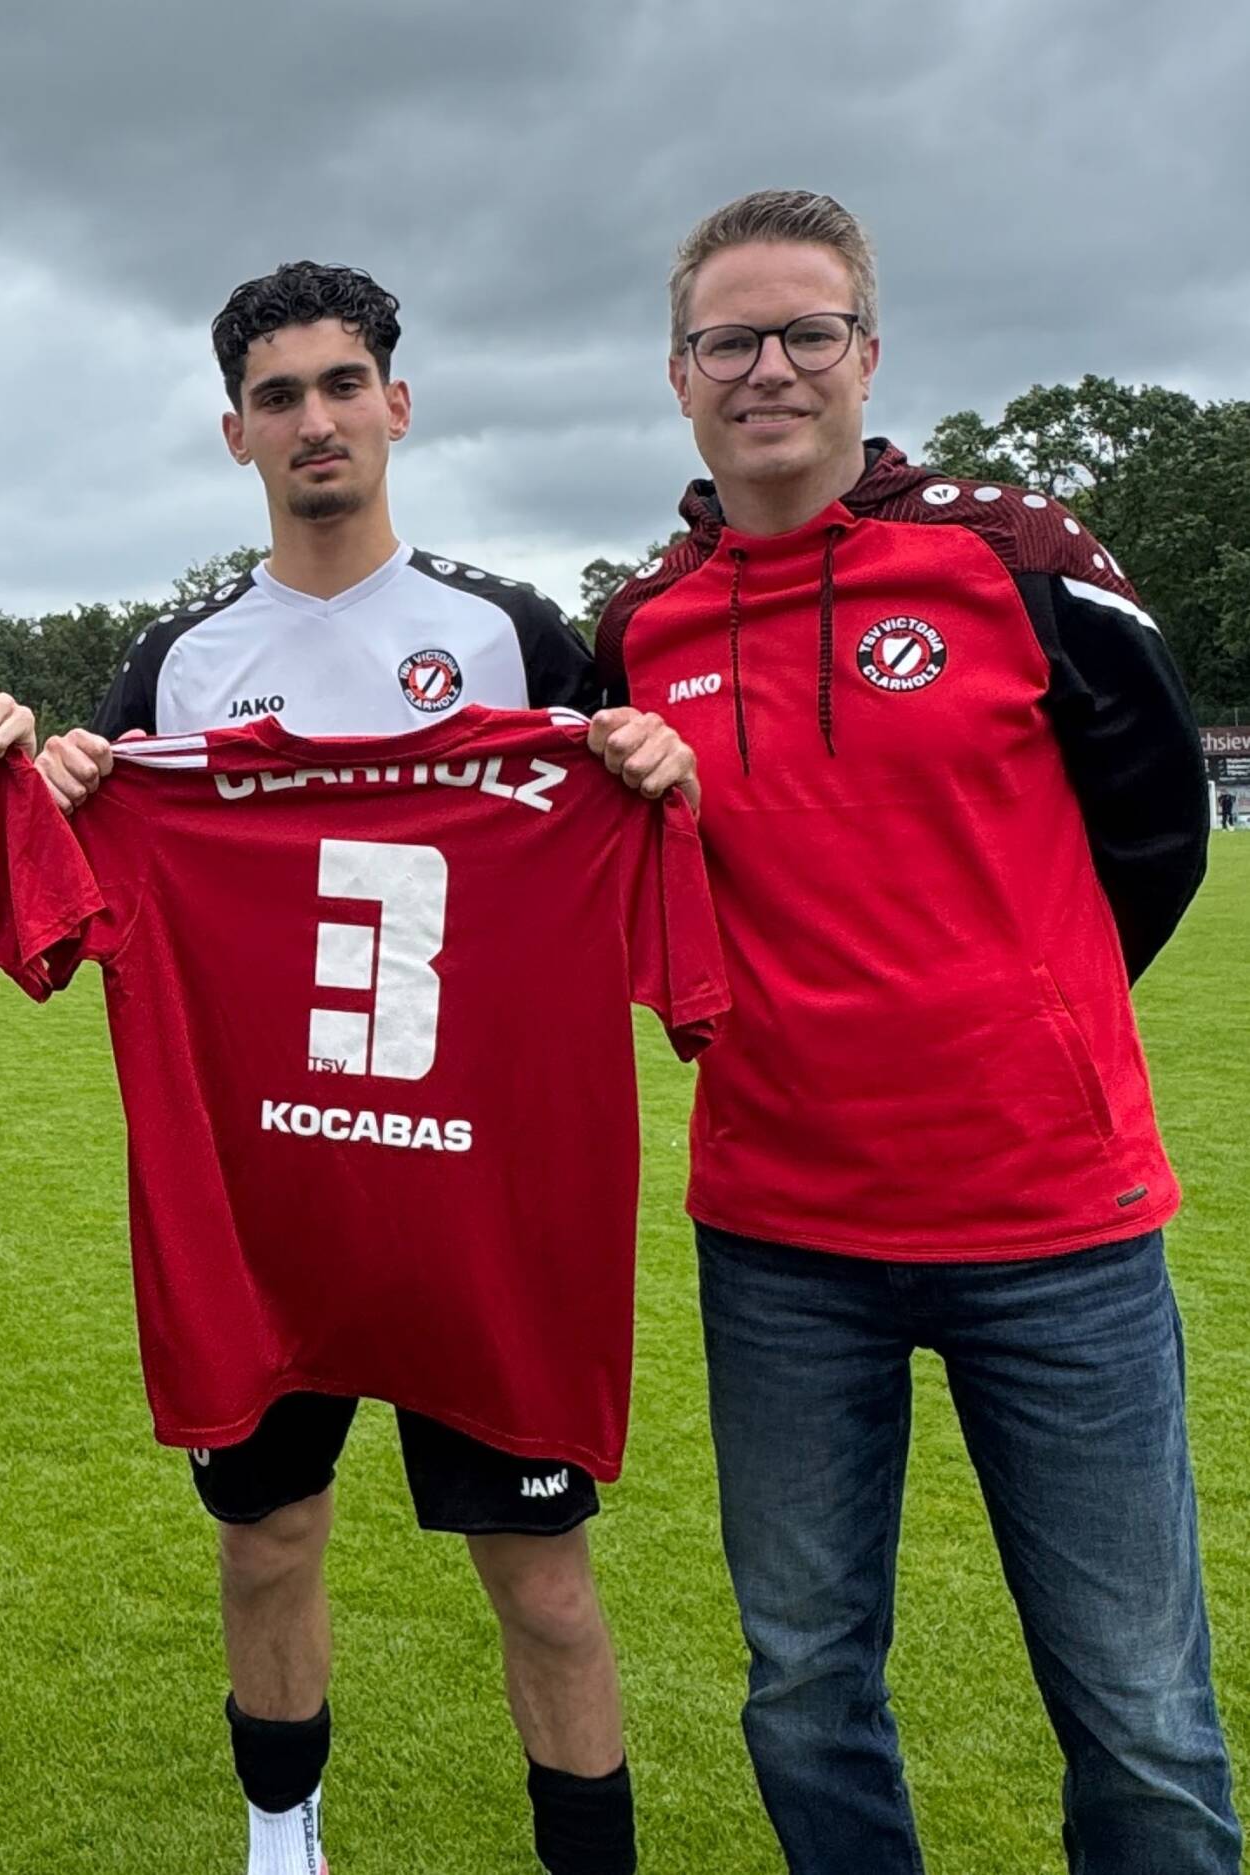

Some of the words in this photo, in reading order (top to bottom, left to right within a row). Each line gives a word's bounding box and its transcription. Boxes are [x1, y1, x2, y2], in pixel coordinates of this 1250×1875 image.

[858, 625, 882, 653] TSV
[880, 617, 945, 654] VICTORIA
[412, 651, 459, 678] VICTORIA
[862, 663, 941, 691] CLARHOLZ
[404, 684, 460, 710] CLARHOLZ
[667, 672, 722, 704] JAKO
[228, 695, 285, 719] JAKO
[308, 838, 449, 1081] 3
[309, 1056, 348, 1074] TSV
[260, 1099, 473, 1153] KOCABAS
